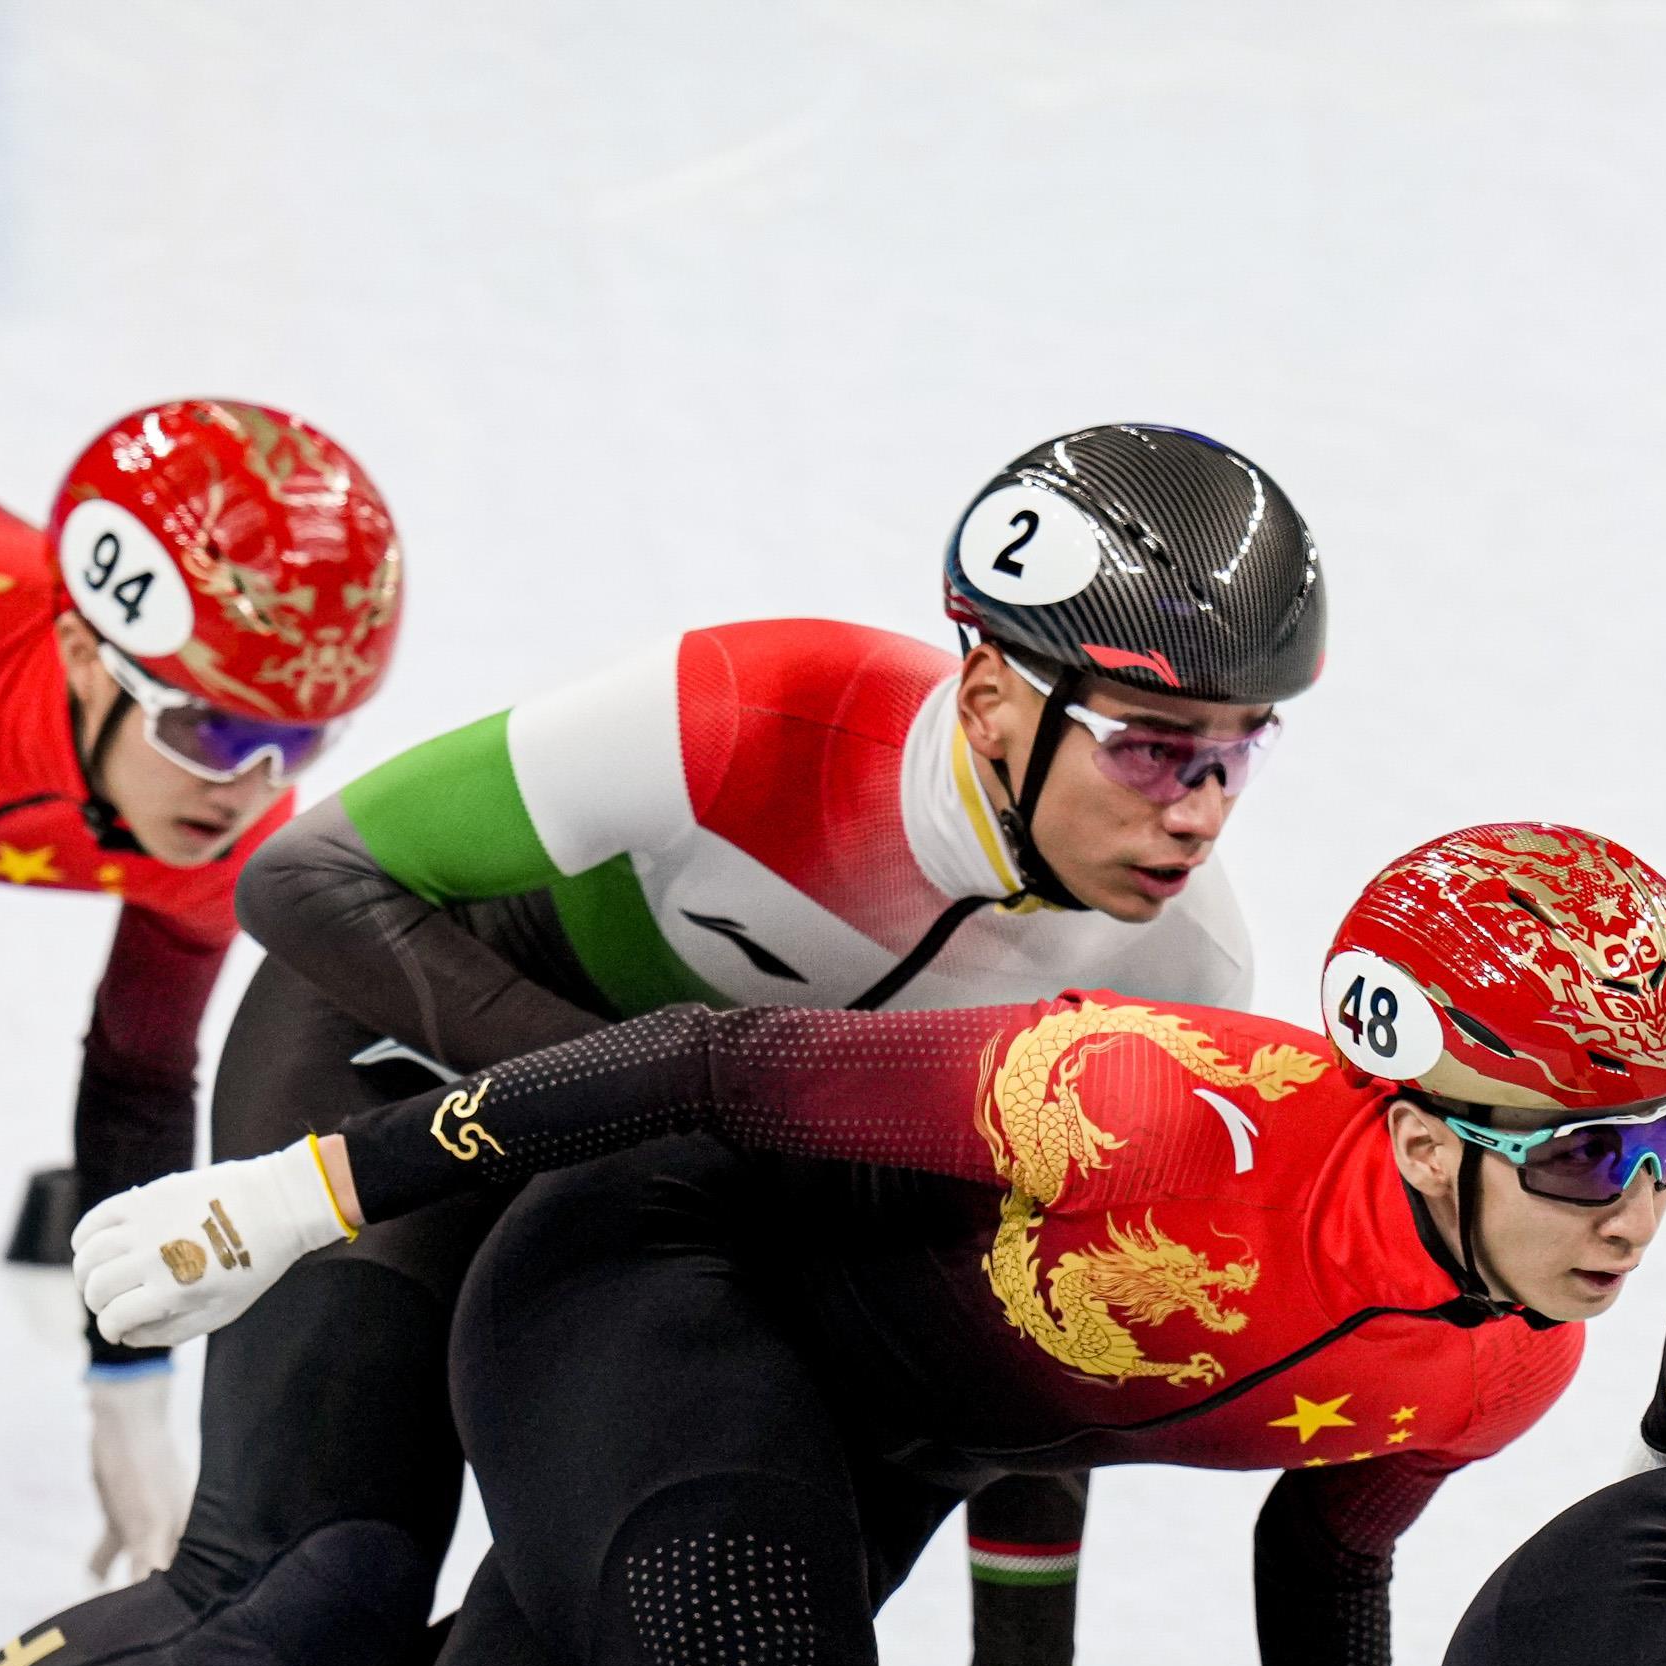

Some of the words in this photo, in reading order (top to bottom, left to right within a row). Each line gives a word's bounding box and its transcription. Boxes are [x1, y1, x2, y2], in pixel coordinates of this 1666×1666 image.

[82, 531, 156, 626] 94
[992, 509, 1041, 579] 2
[1337, 974, 1399, 1059] 48
